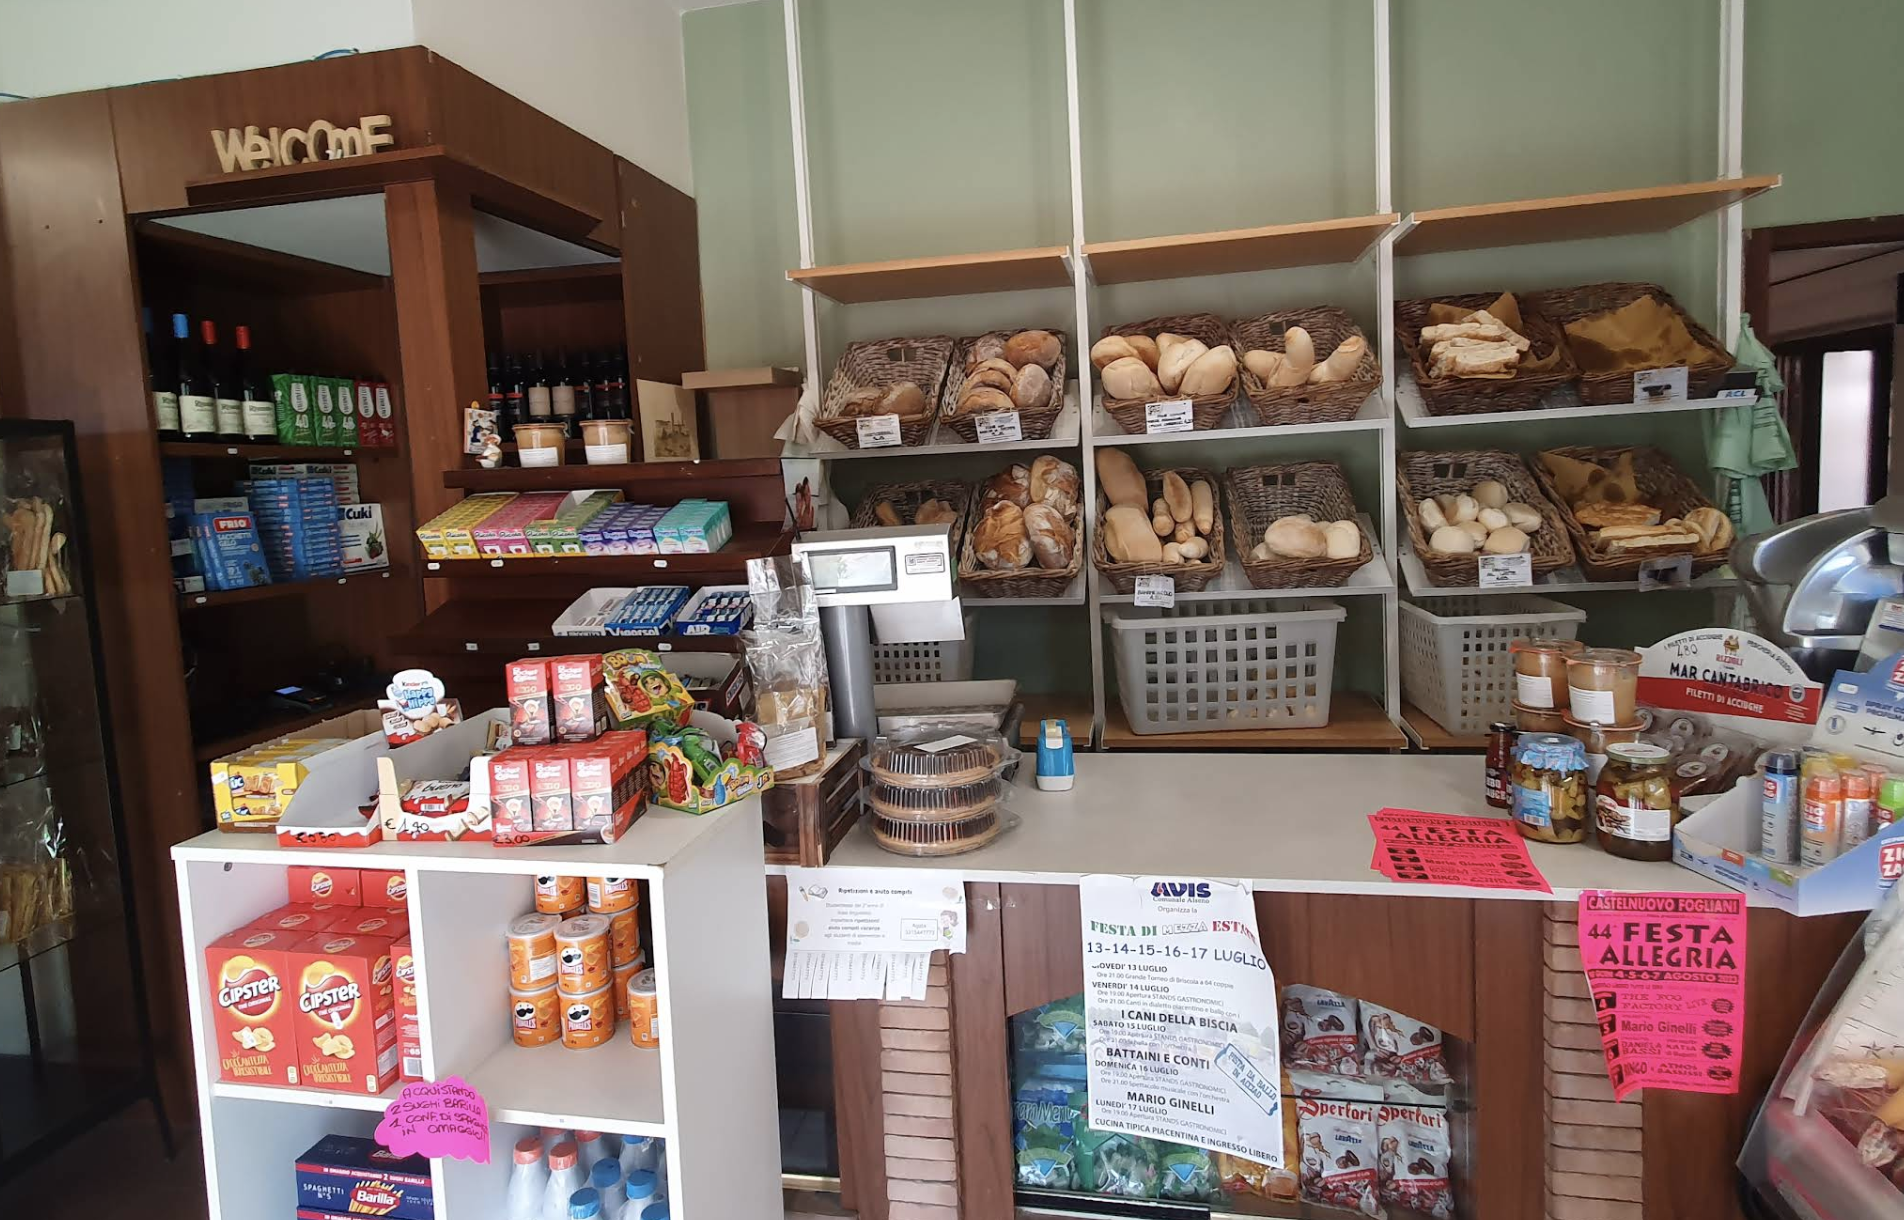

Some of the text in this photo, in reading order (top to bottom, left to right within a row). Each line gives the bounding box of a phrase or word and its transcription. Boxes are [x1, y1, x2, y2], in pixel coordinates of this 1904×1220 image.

[346, 506, 372, 520] Cuki
[1669, 662, 1784, 699] MAR CANTABRICO
[1686, 687, 1763, 713] FILETTI DI ACCIUGHE
[1883, 847, 1904, 862] ZI
[1882, 863, 1902, 877] ZA
[1150, 882, 1211, 898] AVIS
[1588, 896, 1738, 913] CASTELNUOVO FOGLIANI
[1090, 920, 1136, 936] FESTA
[1141, 926, 1157, 936] DI
[1162, 921, 1208, 935] MEZZA
[1623, 922, 1734, 945] FESTA
[1087, 942, 1267, 971] 13-14-15-16-17 LUGLIO
[1599, 943, 1737, 970] ALLEGRIA
[1138, 965, 1168, 973] LUGLIO
[1664, 972, 1716, 982] AGOSTO
[218, 976, 281, 1007] CIPSTER
[1126, 991, 1151, 999] Apertura
[1140, 985, 1169, 993] LUGLIO
[299, 983, 361, 1013] CIPSTER
[1093, 1020, 1125, 1029] SABATO
[1137, 1024, 1167, 1033] LUGLIO
[1121, 1010, 1238, 1033] I CANI DELLA BISCIA
[1621, 1020, 1697, 1035] Mario Ginelli
[1106, 1047, 1210, 1070] BATTAINI E CONTI
[1095, 1060, 1137, 1071] DOMENICA
[1149, 1066, 1179, 1075] LUGLIO
[391, 1104, 401, 1115] 2
[1127, 1091, 1215, 1115] MARIO GINELLI
[1138, 1105, 1168, 1115] LUGLIO
[1299, 1088, 1373, 1123] Sperlari
[1094, 1118, 1278, 1163] CUCINA TIPICA PIACENTINA E INGRESSO LIBERO
[303, 1183, 345, 1195] SPAGHETTI
[356, 1190, 395, 1205] Barilla
